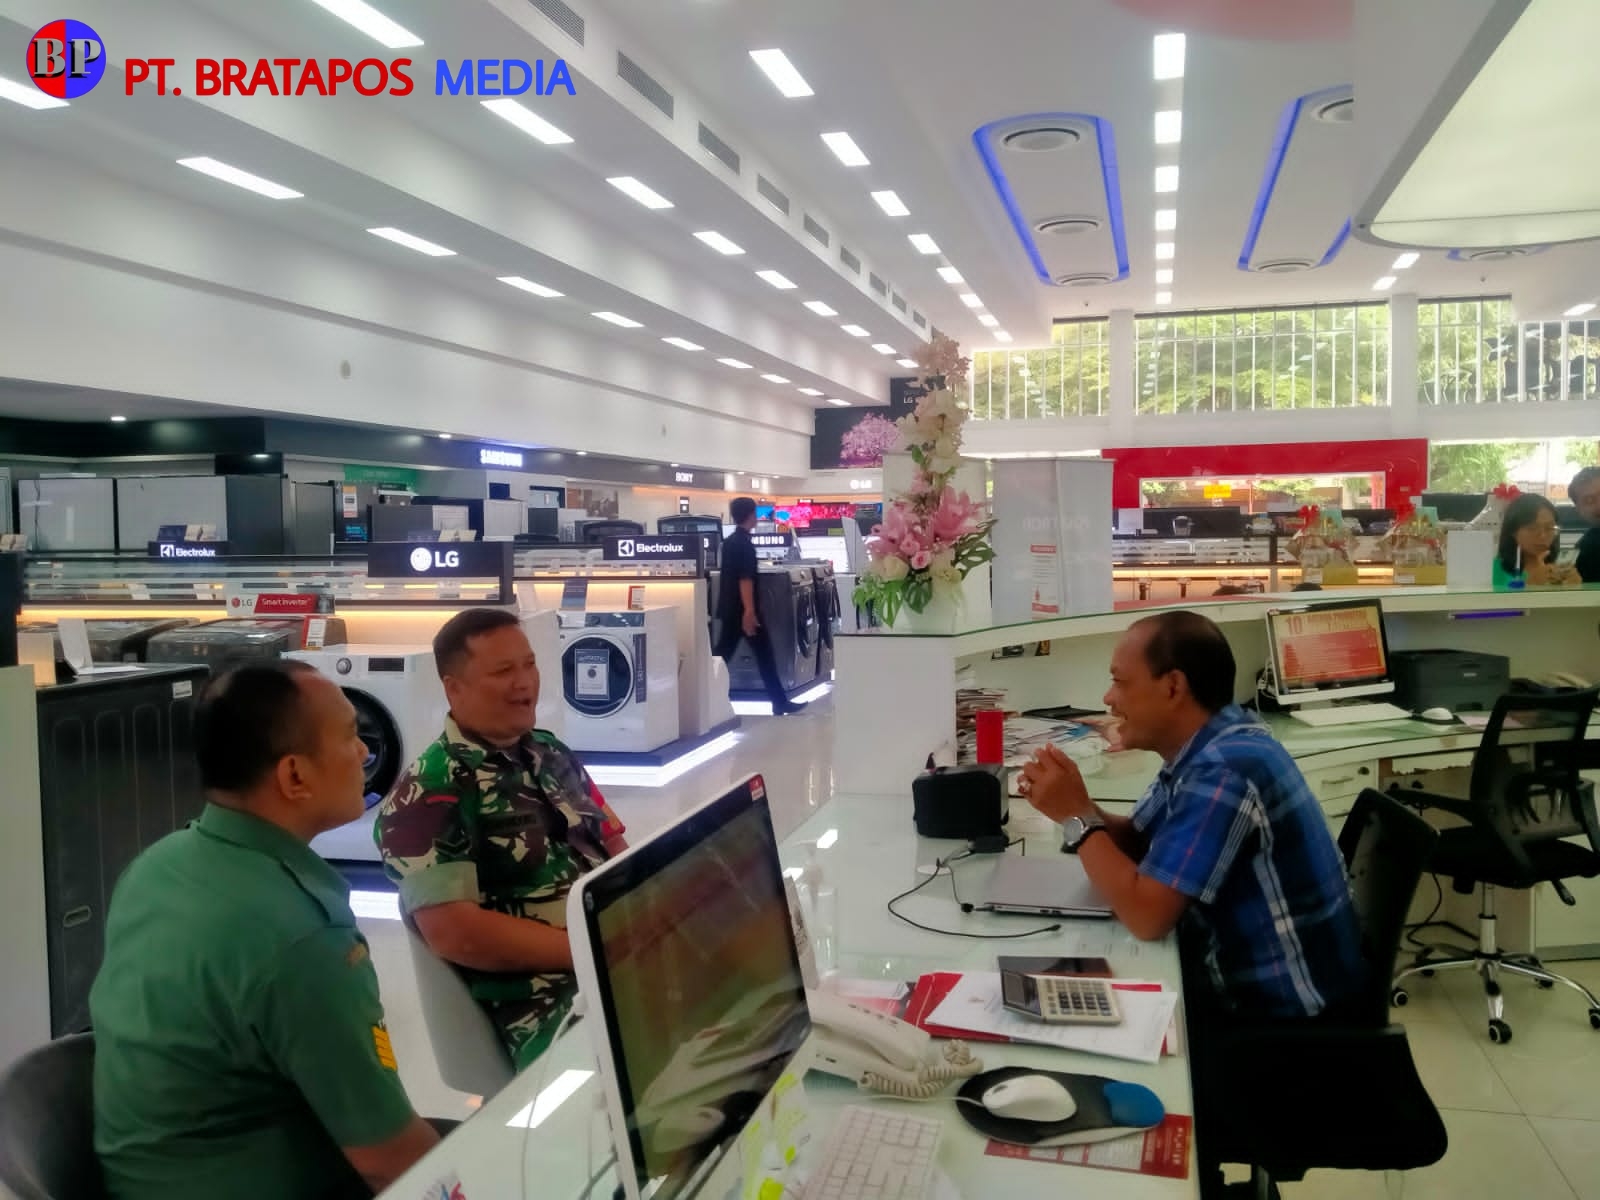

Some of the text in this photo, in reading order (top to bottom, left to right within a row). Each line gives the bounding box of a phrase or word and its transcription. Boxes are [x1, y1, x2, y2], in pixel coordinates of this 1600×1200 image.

[175, 547, 216, 557] Electrolux
[636, 543, 684, 553] Electrolux
[434, 550, 460, 568] LG
